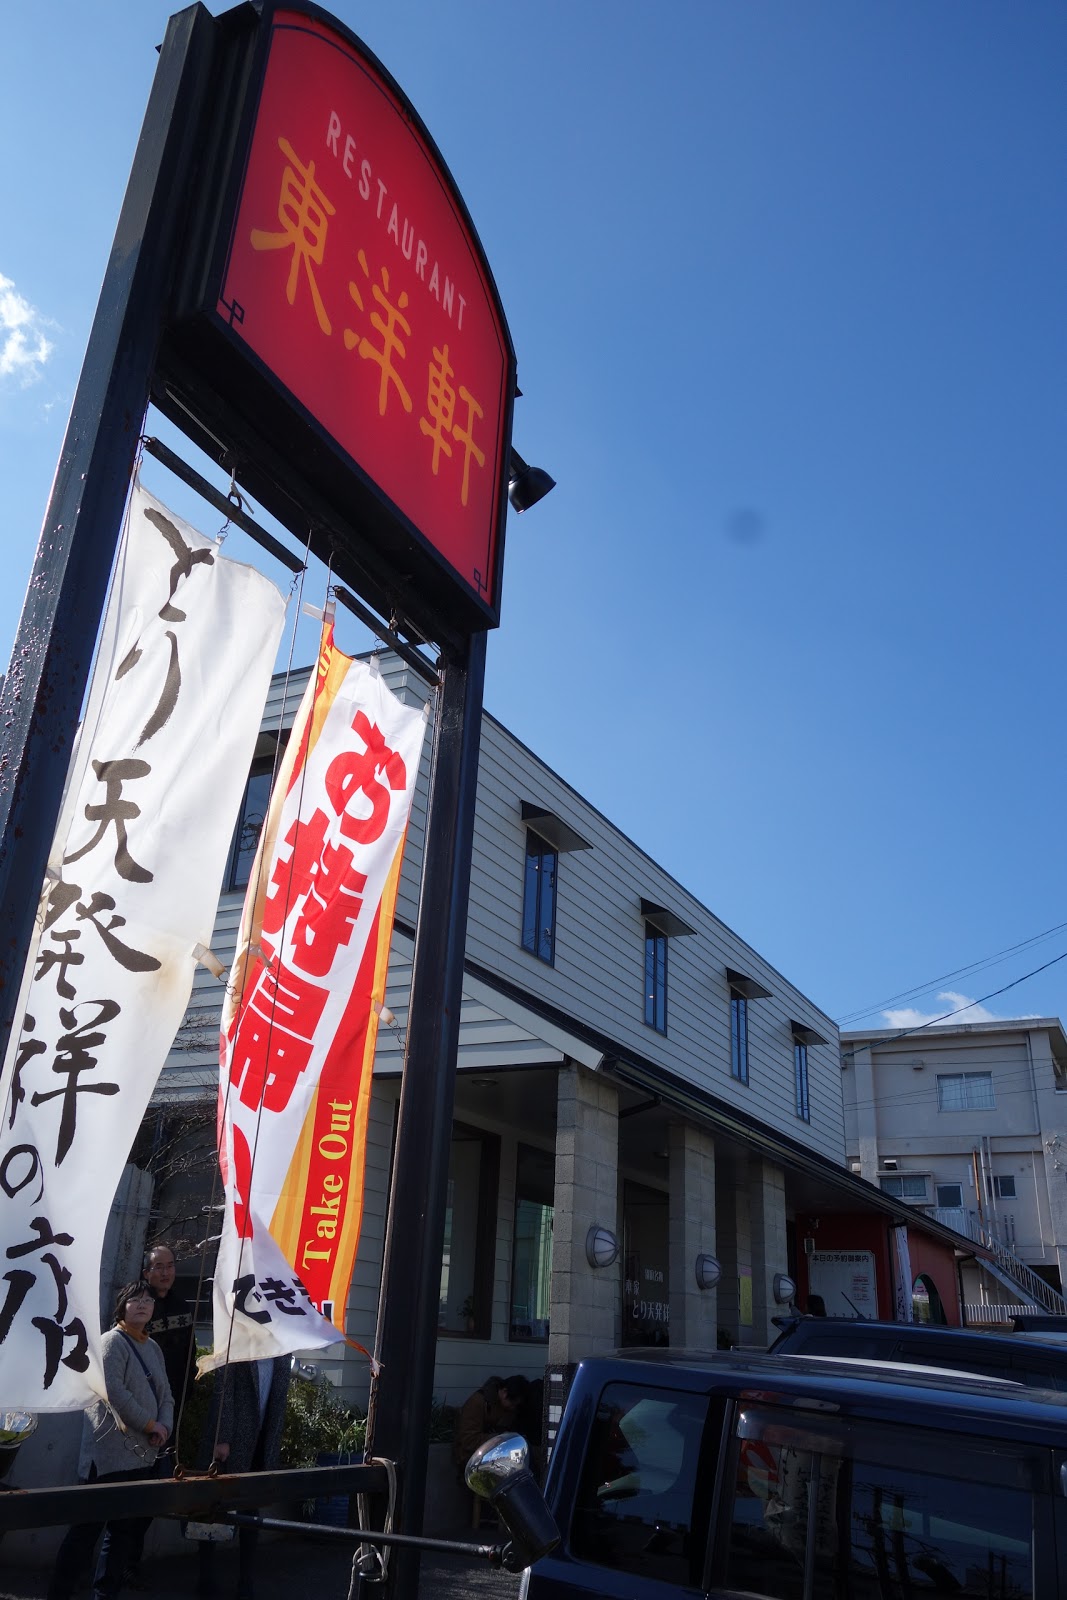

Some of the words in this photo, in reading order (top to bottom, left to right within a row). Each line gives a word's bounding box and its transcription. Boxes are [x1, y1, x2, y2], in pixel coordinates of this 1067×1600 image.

[327, 110, 467, 332] RESTAURANT
[250, 135, 486, 507] 東洋軒
[318, 1098, 353, 1160] Out
[302, 1173, 343, 1271] Take
[812, 1254, 870, 1263] 本日の予約御案内
